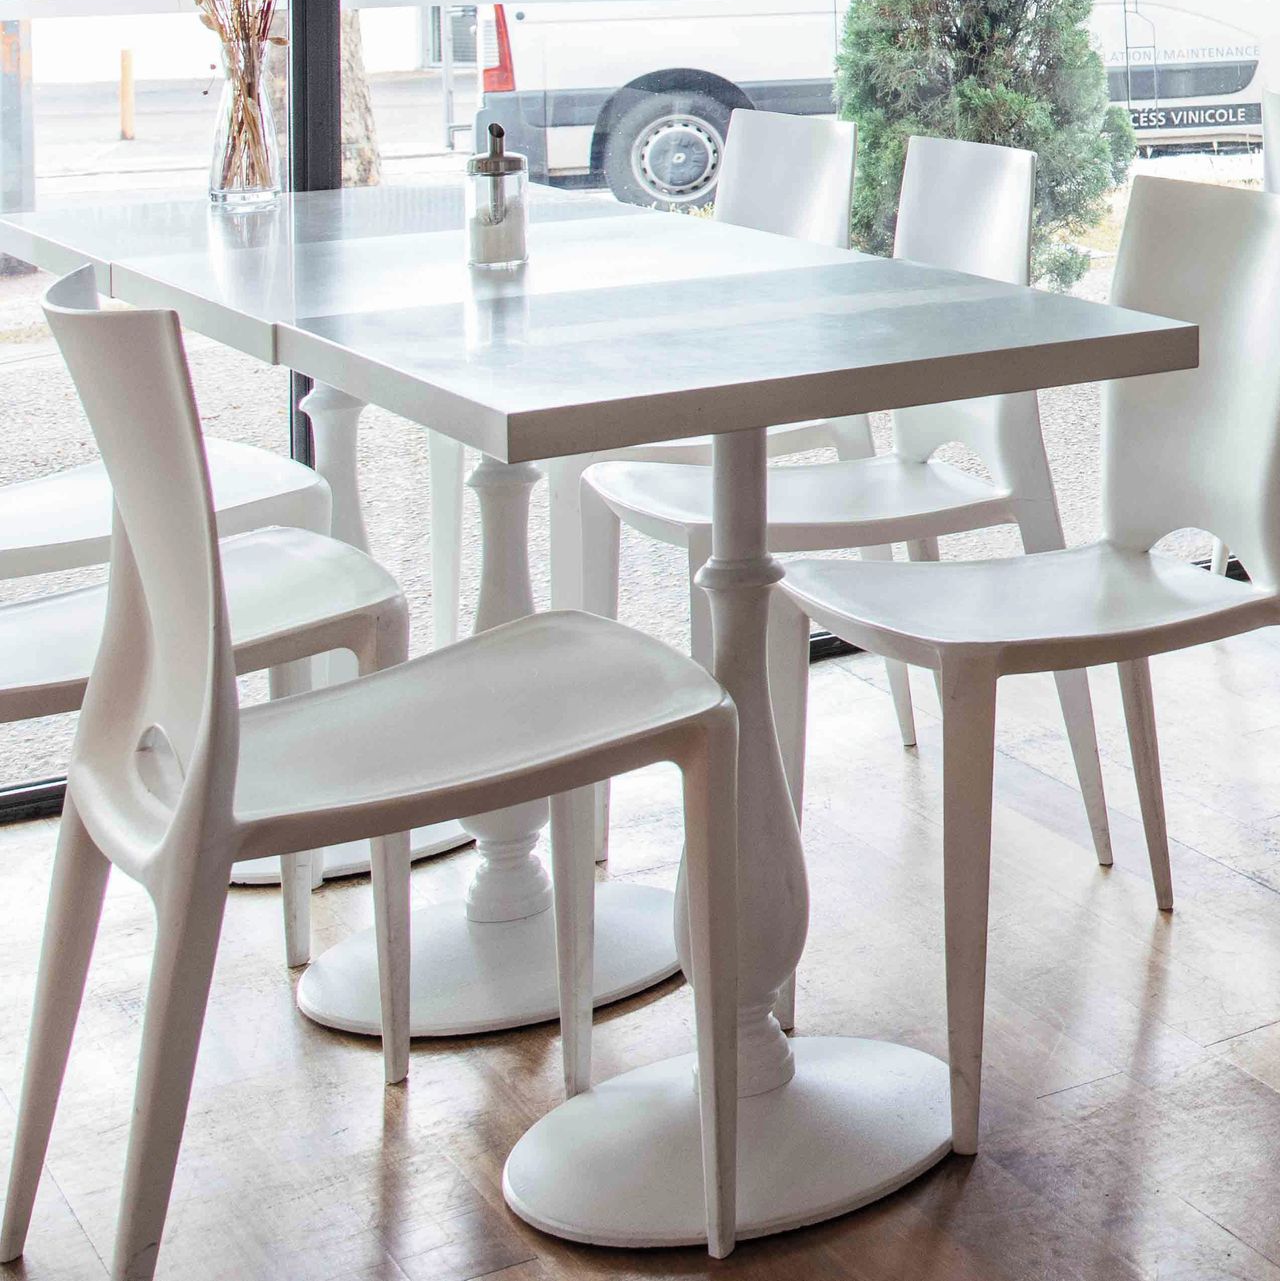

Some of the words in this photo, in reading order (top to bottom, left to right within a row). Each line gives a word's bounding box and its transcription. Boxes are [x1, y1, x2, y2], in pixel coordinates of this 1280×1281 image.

[1103, 50, 1152, 63] LATION
[1163, 45, 1261, 60] MAINTENANCE
[1130, 111, 1166, 127] CESS
[1170, 108, 1246, 125] VINICOLE
